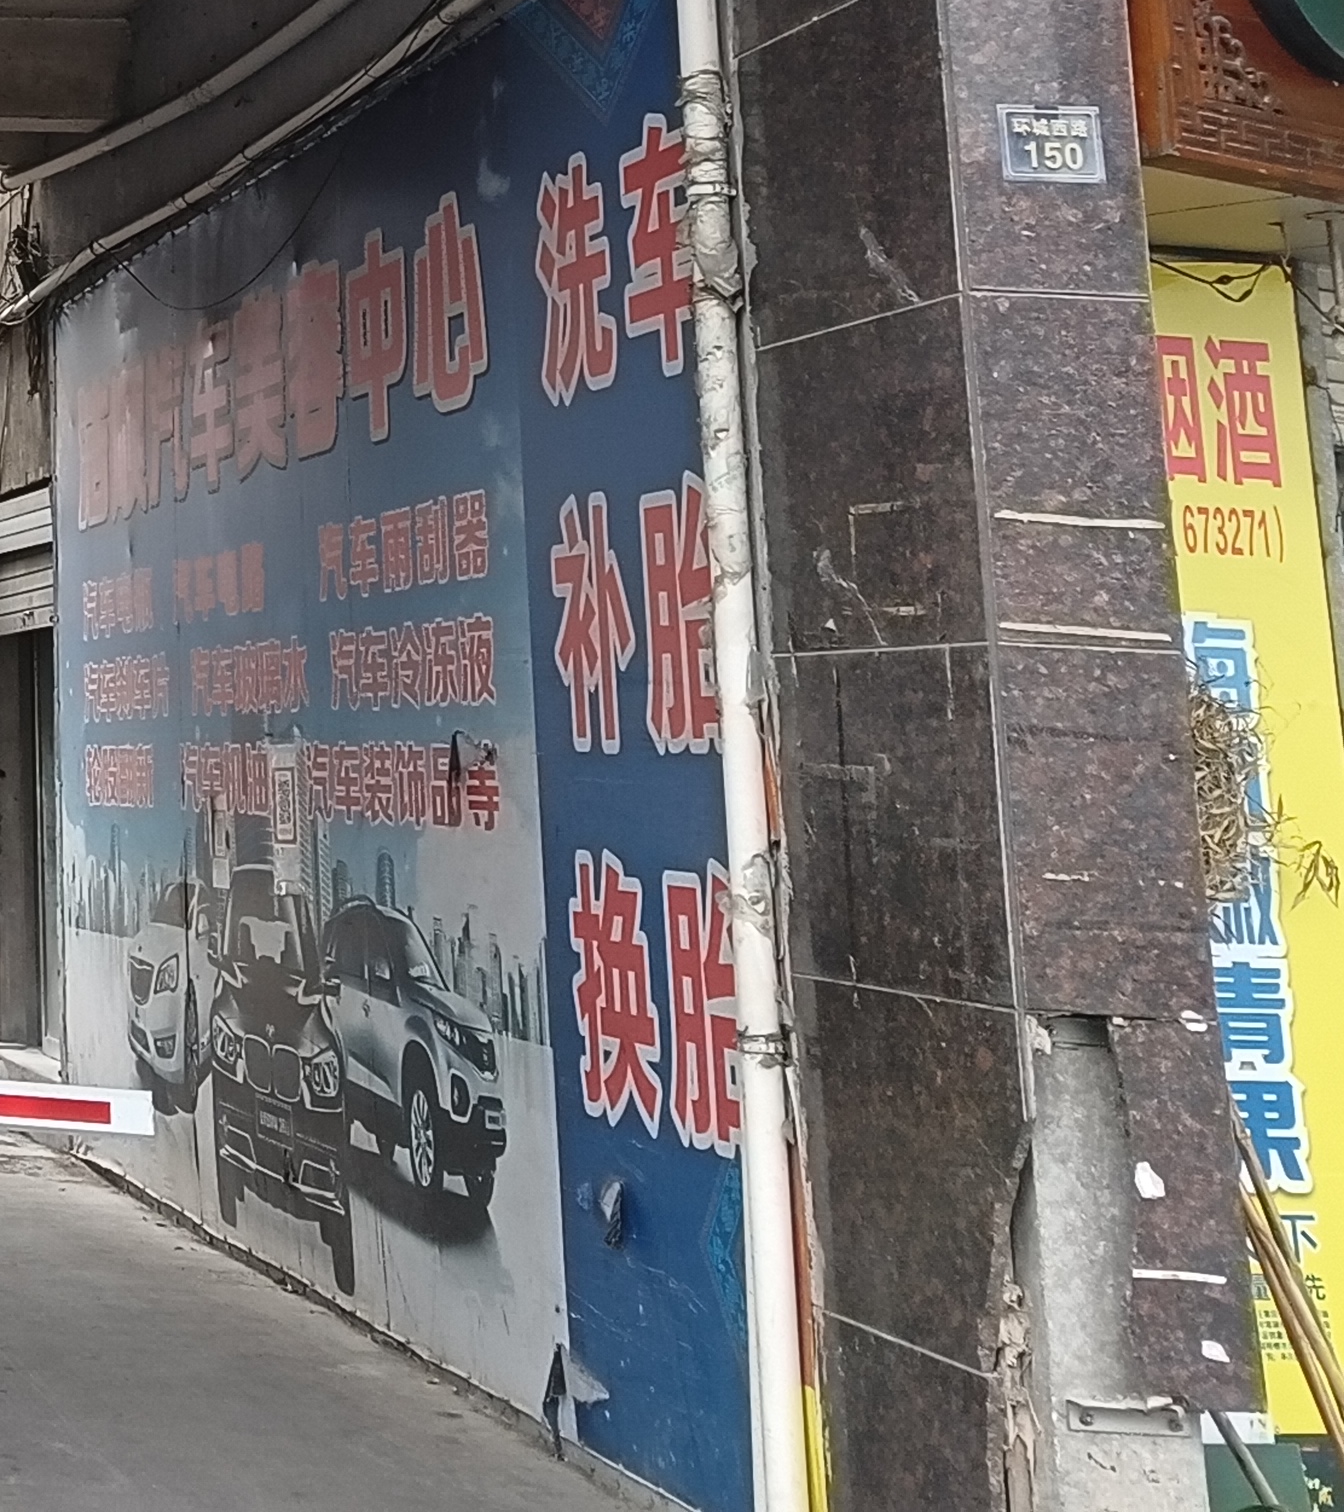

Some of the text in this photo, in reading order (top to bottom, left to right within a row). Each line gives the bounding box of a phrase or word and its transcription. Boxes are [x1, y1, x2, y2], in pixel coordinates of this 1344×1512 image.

[1024, 141, 1083, 170] 150
[535, 113, 695, 407] 洗车
[318, 489, 489, 601] 汽车雨刮器
[551, 469, 723, 755] 补胎
[329, 612, 497, 711] 汽车冷冻液
[569, 848, 743, 1159] 换胎
